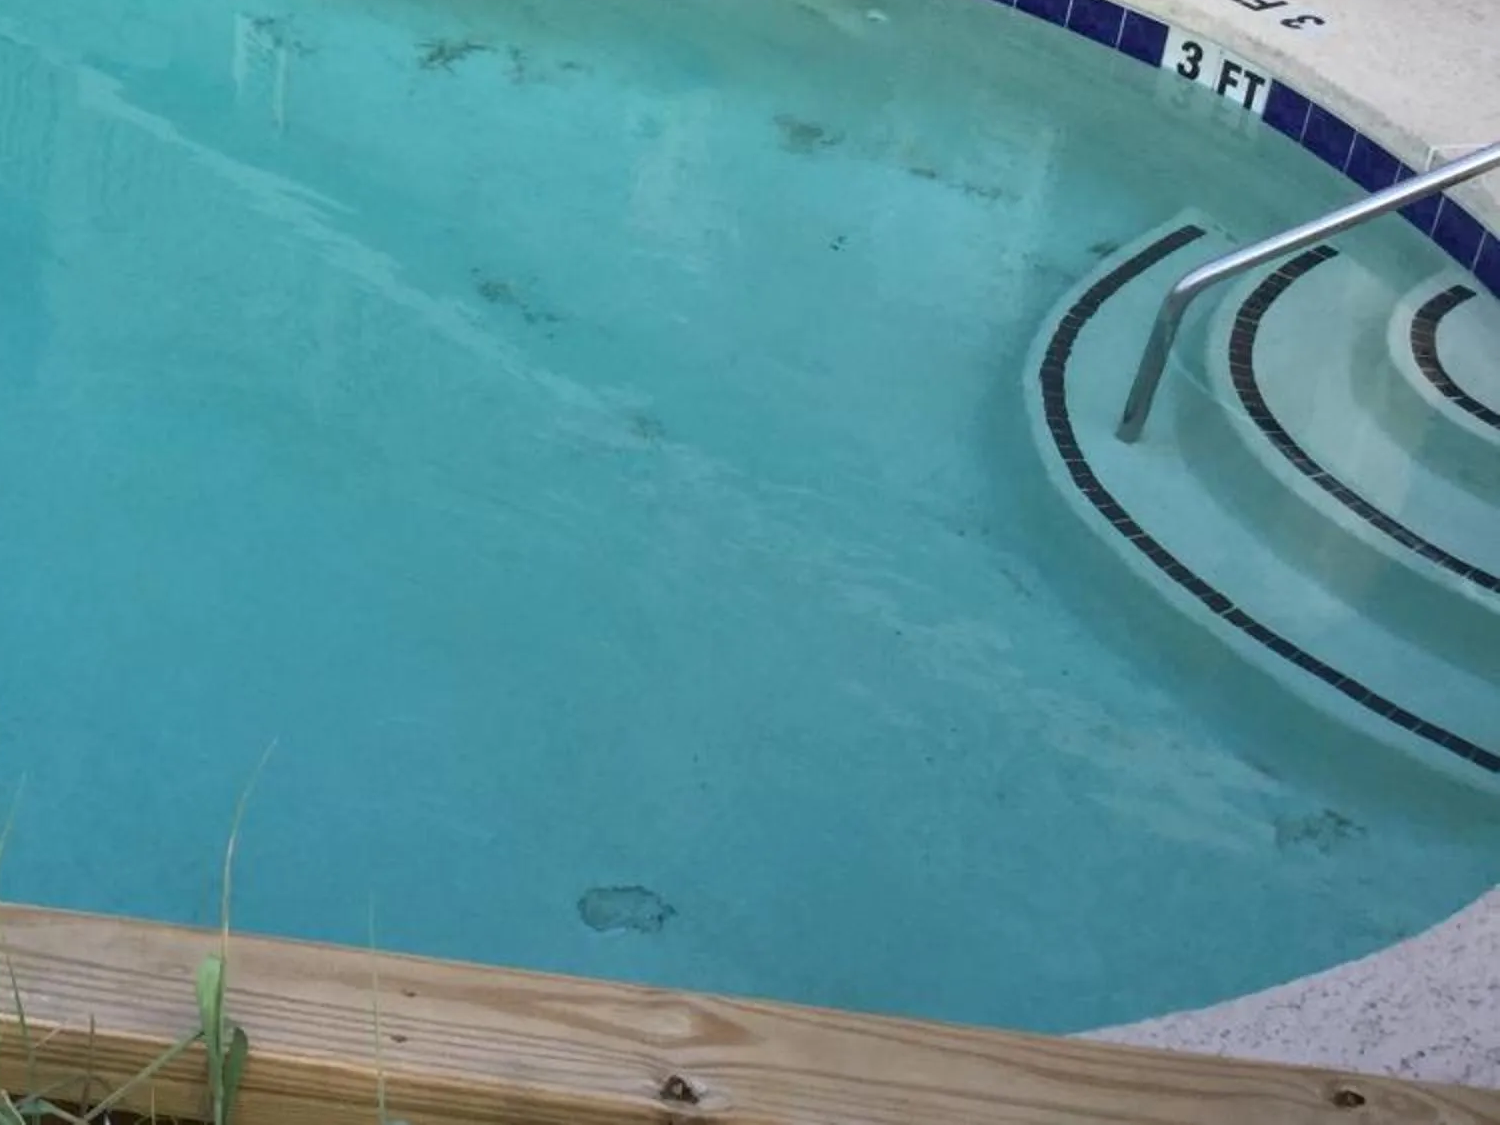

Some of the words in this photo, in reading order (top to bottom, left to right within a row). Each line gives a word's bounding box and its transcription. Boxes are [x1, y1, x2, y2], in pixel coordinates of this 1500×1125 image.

[1280, 15, 1326, 30] 3
[1176, 40, 1204, 81] 3
[1216, 58, 1266, 111] FT
